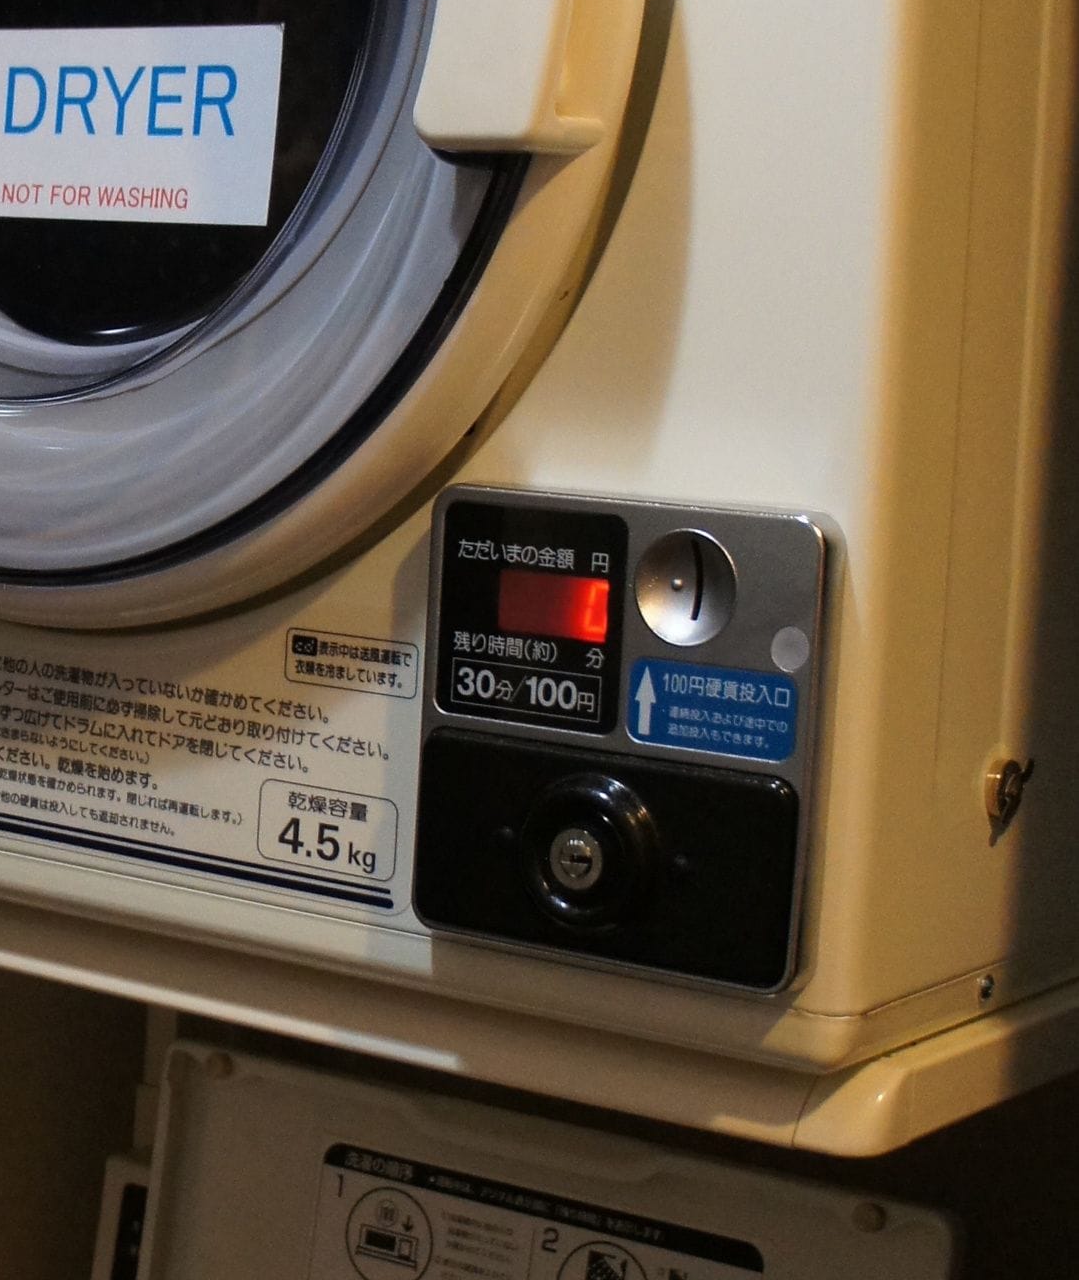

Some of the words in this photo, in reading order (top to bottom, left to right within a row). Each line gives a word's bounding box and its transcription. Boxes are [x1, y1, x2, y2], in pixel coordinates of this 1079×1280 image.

[4, 64, 238, 137] DRYER
[1, 183, 43, 204] NOT
[50, 185, 91, 206] FOR
[97, 186, 189, 210] WASHING
[457, 538, 575, 570] ただいまの金額
[591, 552, 610, 574] 円
[585, 648, 605, 670] 分
[663, 672, 791, 709] 100円硬貨投入口
[288, 791, 369, 823] 乾燥容量
[540, 1227, 559, 1254] 2
